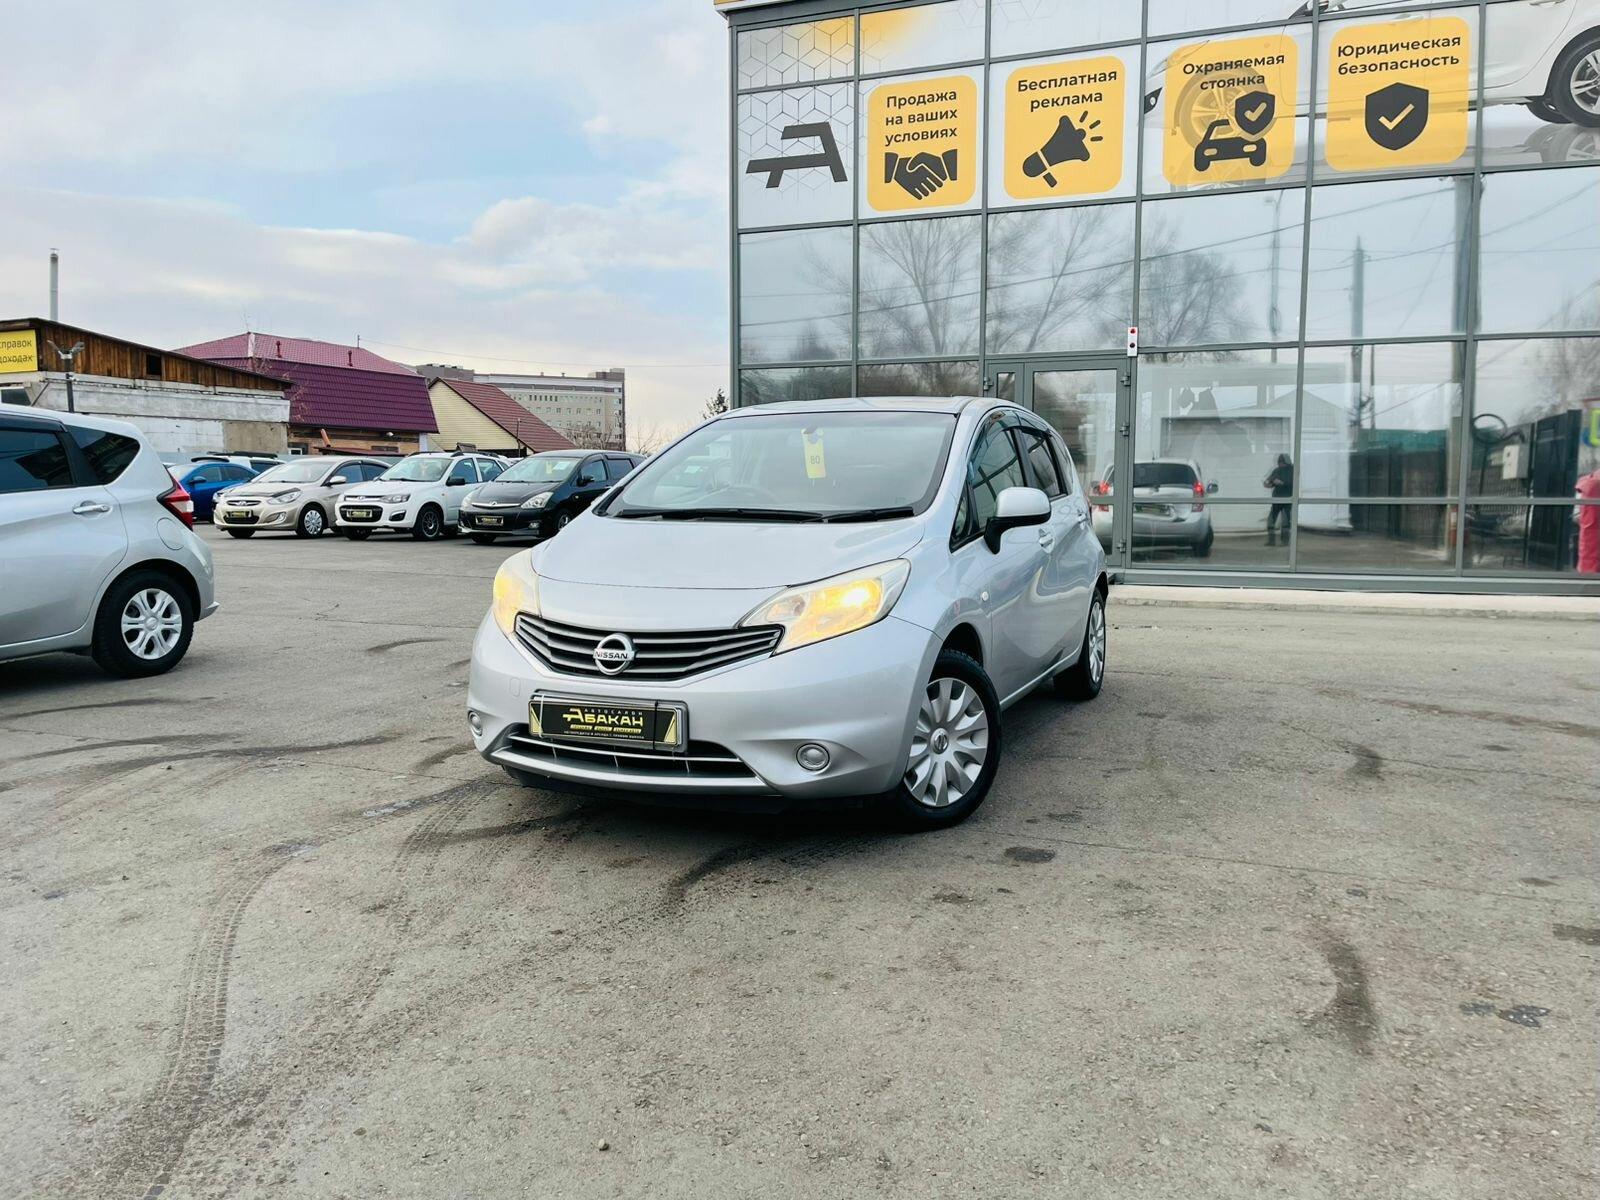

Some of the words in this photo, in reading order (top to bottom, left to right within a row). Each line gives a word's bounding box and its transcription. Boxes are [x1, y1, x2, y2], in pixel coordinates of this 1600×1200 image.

[1338, 36, 1461, 58] Юридическая
[1183, 55, 1285, 75] Охраняемая
[1338, 55, 1460, 75] безопасность
[1018, 70, 1117, 92] Бесплатная
[1200, 75, 1265, 90] стоянка
[886, 91, 957, 109] Продажа
[1030, 92, 1103, 112] реклама
[885, 115, 903, 126] на
[908, 109, 958, 124] ваших
[885, 128, 957, 147] условиях
[0, 339, 32, 351] правок
[810, 455, 820, 465] 80
[594, 650, 628, 660] NISSAN
[562, 707, 643, 727] АБАКАН
